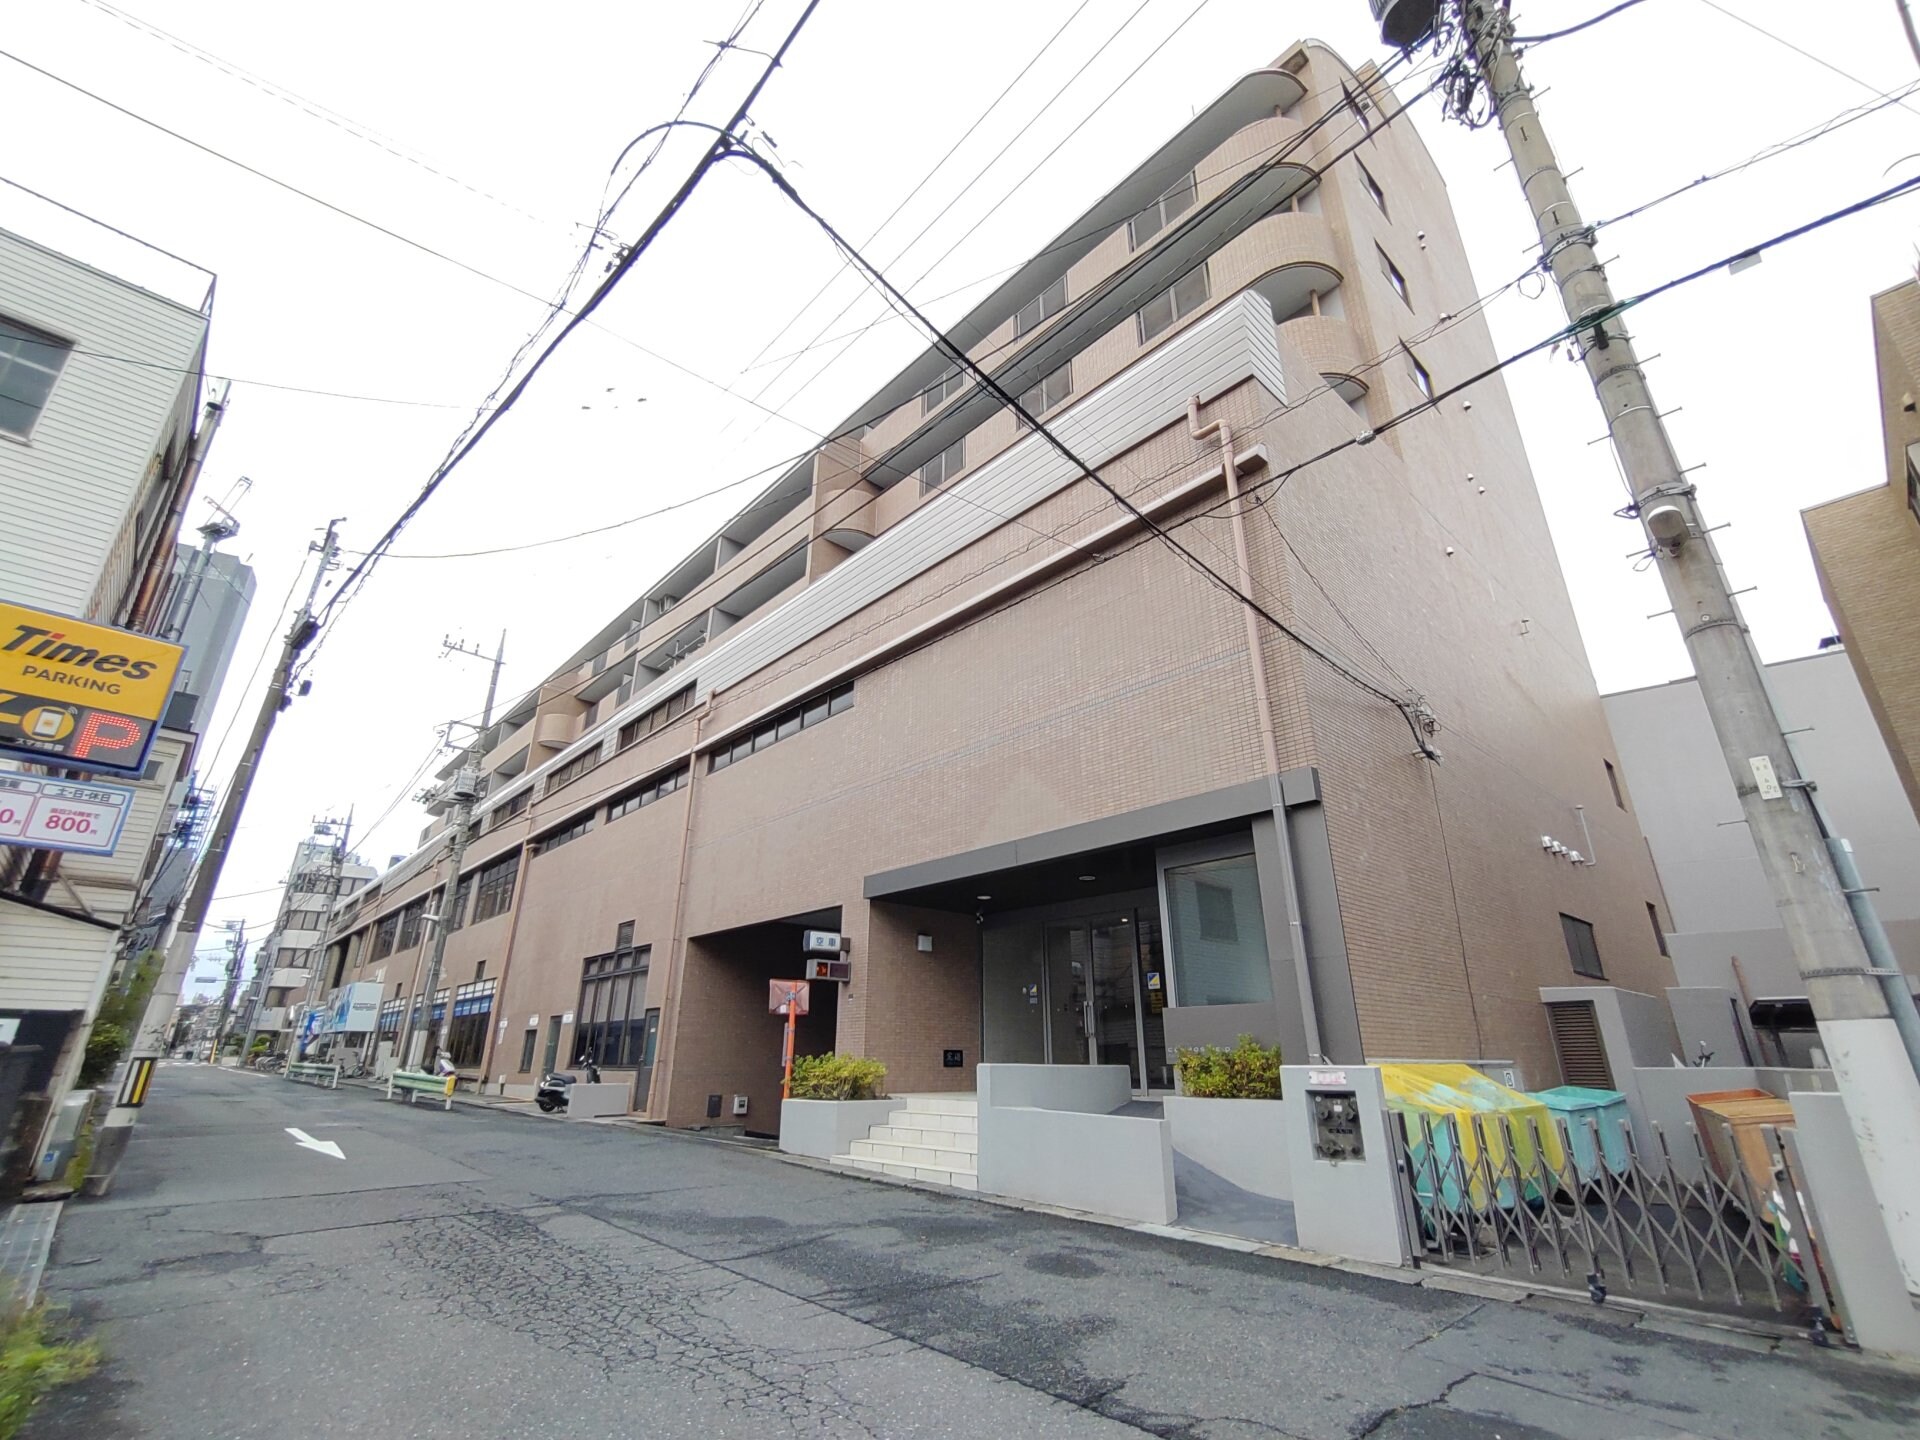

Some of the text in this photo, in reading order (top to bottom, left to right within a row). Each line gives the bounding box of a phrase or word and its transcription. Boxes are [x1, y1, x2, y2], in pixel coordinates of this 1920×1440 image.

[3, 624, 157, 680] Times
[22, 665, 121, 695] PARKING
[73, 712, 141, 759] P
